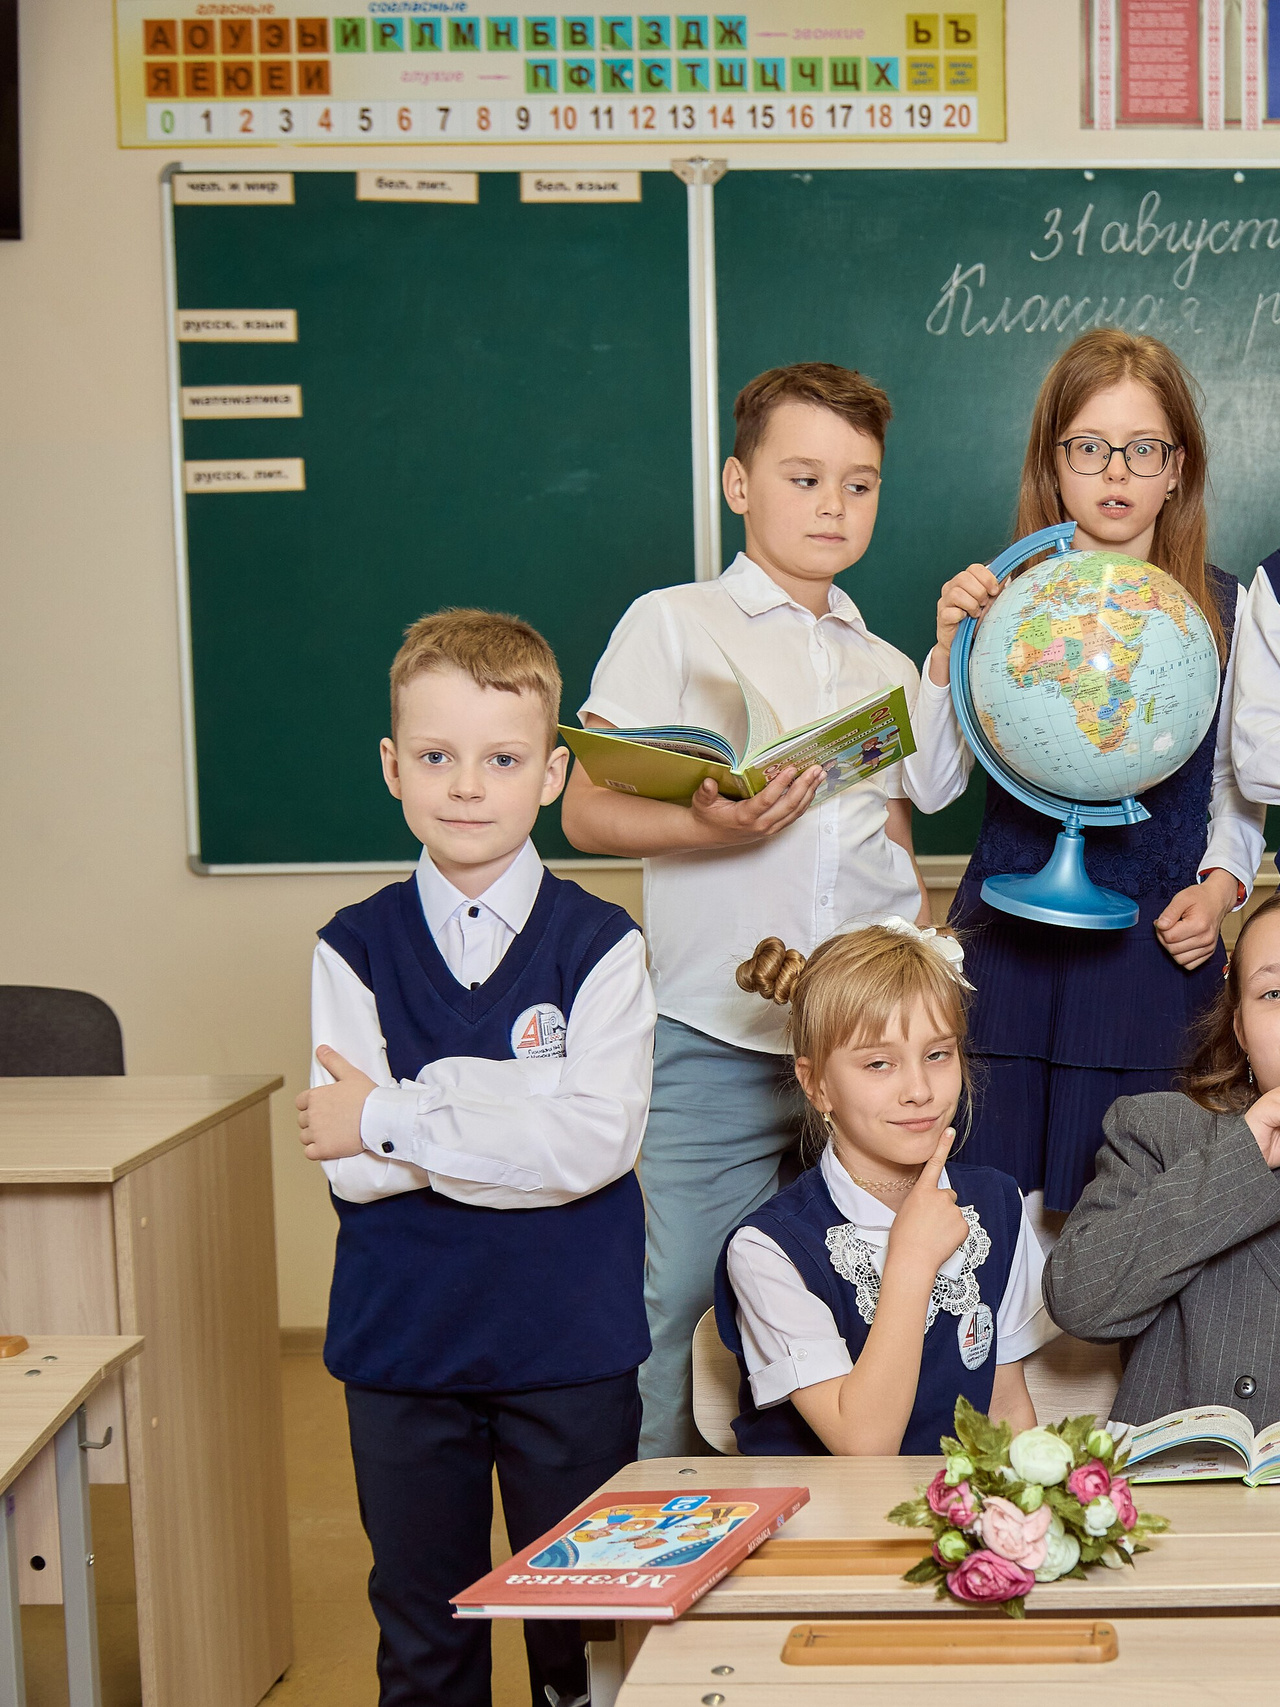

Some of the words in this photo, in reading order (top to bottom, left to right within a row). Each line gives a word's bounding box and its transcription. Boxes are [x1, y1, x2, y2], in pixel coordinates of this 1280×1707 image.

[149, 23, 170, 50] А
[188, 24, 209, 50] О
[228, 24, 245, 49] У
[265, 24, 284, 48] Э
[301, 23, 327, 48] Ы
[340, 18, 360, 47] Й
[380, 22, 397, 47] Р
[415, 22, 434, 47] Л
[453, 22, 475, 47] М
[495, 23, 512, 46] Н
[532, 22, 550, 46] Б
[570, 22, 588, 45] В
[610, 21, 624, 44] Г
[647, 20, 661, 44] З
[681, 21, 702, 47] Д
[717, 19, 743, 44] Ж
[913, 19, 932, 44] Ь
[947, 20, 972, 44] Ъ
[151, 66, 171, 91] Я
[194, 61, 210, 91] Ё
[225, 66, 253, 91] Ю
[268, 66, 285, 90] Е
[305, 65, 324, 90] И
[532, 65, 550, 89] П
[569, 63, 591, 88] Ф
[610, 64, 625, 88] К
[647, 63, 664, 87] С
[684, 63, 701, 87] Т
[719, 62, 743, 87] Ш
[760, 62, 781, 91] Ц
[799, 61, 817, 86] Ч
[832, 62, 860, 90] Щ
[874, 61, 892, 86] Х
[160, 109, 175, 134] 0
[201, 110, 213, 133] 1
[238, 109, 255, 133] 2
[279, 108, 295, 133] 3
[317, 108, 335, 132] 4
[358, 107, 374, 132] 5
[397, 107, 413, 132] 6
[437, 107, 452, 131] 7
[476, 107, 492, 131] 8
[516, 107, 531, 131] 9
[550, 106, 578, 131] 10
[590, 106, 614, 130] 11
[629, 106, 656, 130] 12
[668, 105, 696, 130] 13
[708, 105, 736, 130] 14
[747, 105, 775, 129] 15
[787, 105, 815, 129] 16
[827, 105, 853, 129] 17
[866, 105, 893, 129] 18
[905, 104, 932, 128] 19
[943, 104, 971, 128] 20
[1030, 202, 1096, 262] 31
[868, 705, 893, 726] 2
[505, 1571, 677, 1590] Музыка
